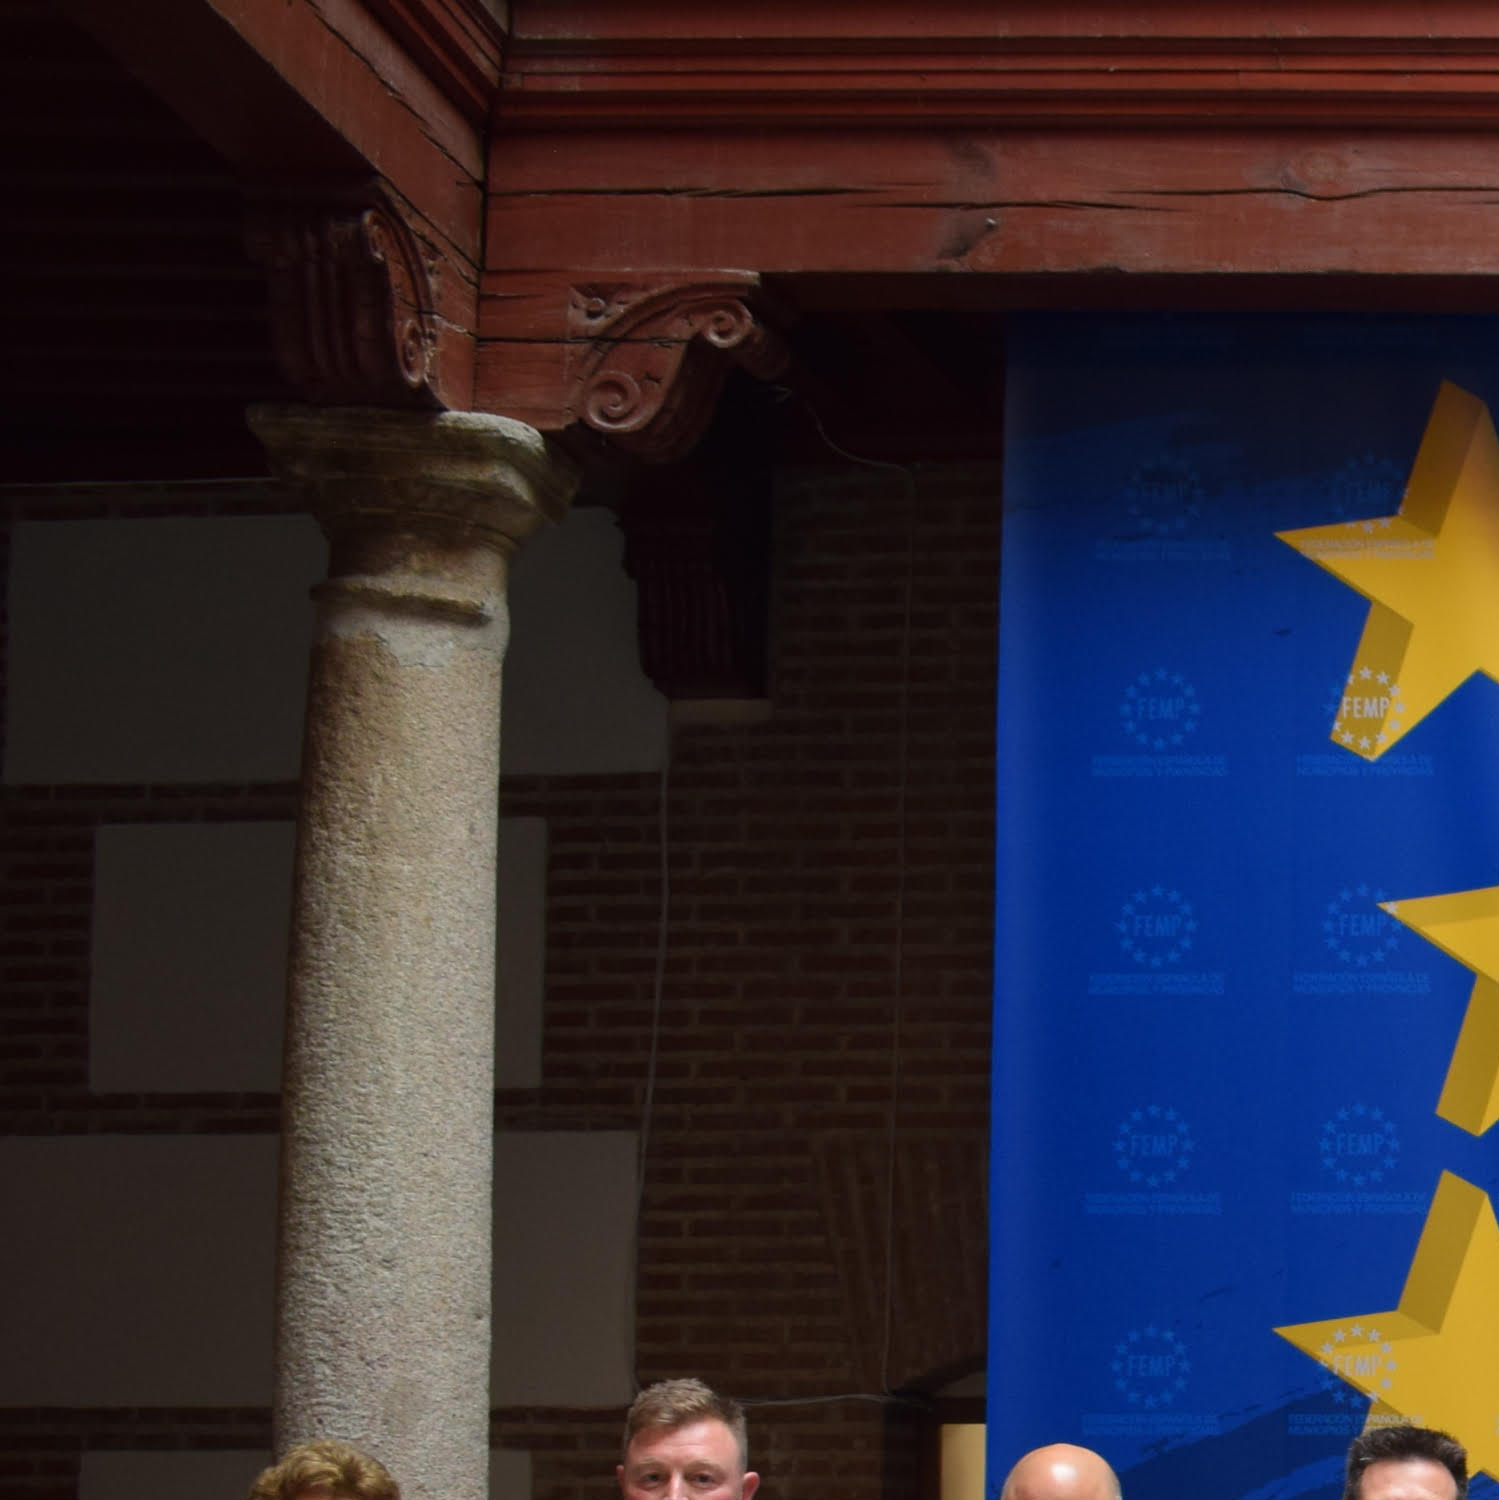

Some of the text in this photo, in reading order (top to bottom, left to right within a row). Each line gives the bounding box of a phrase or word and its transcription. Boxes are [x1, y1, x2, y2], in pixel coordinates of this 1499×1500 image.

[1137, 697, 1185, 720] FEMP
[1342, 696, 1390, 719] FEMP
[1134, 914, 1182, 937] FEMP
[1339, 914, 1387, 937] FEMP
[1130, 1134, 1178, 1157] FEMP
[1336, 1133, 1384, 1156] FEMP
[1128, 1354, 1176, 1377] FEMP
[1333, 1354, 1381, 1377] FEMP
